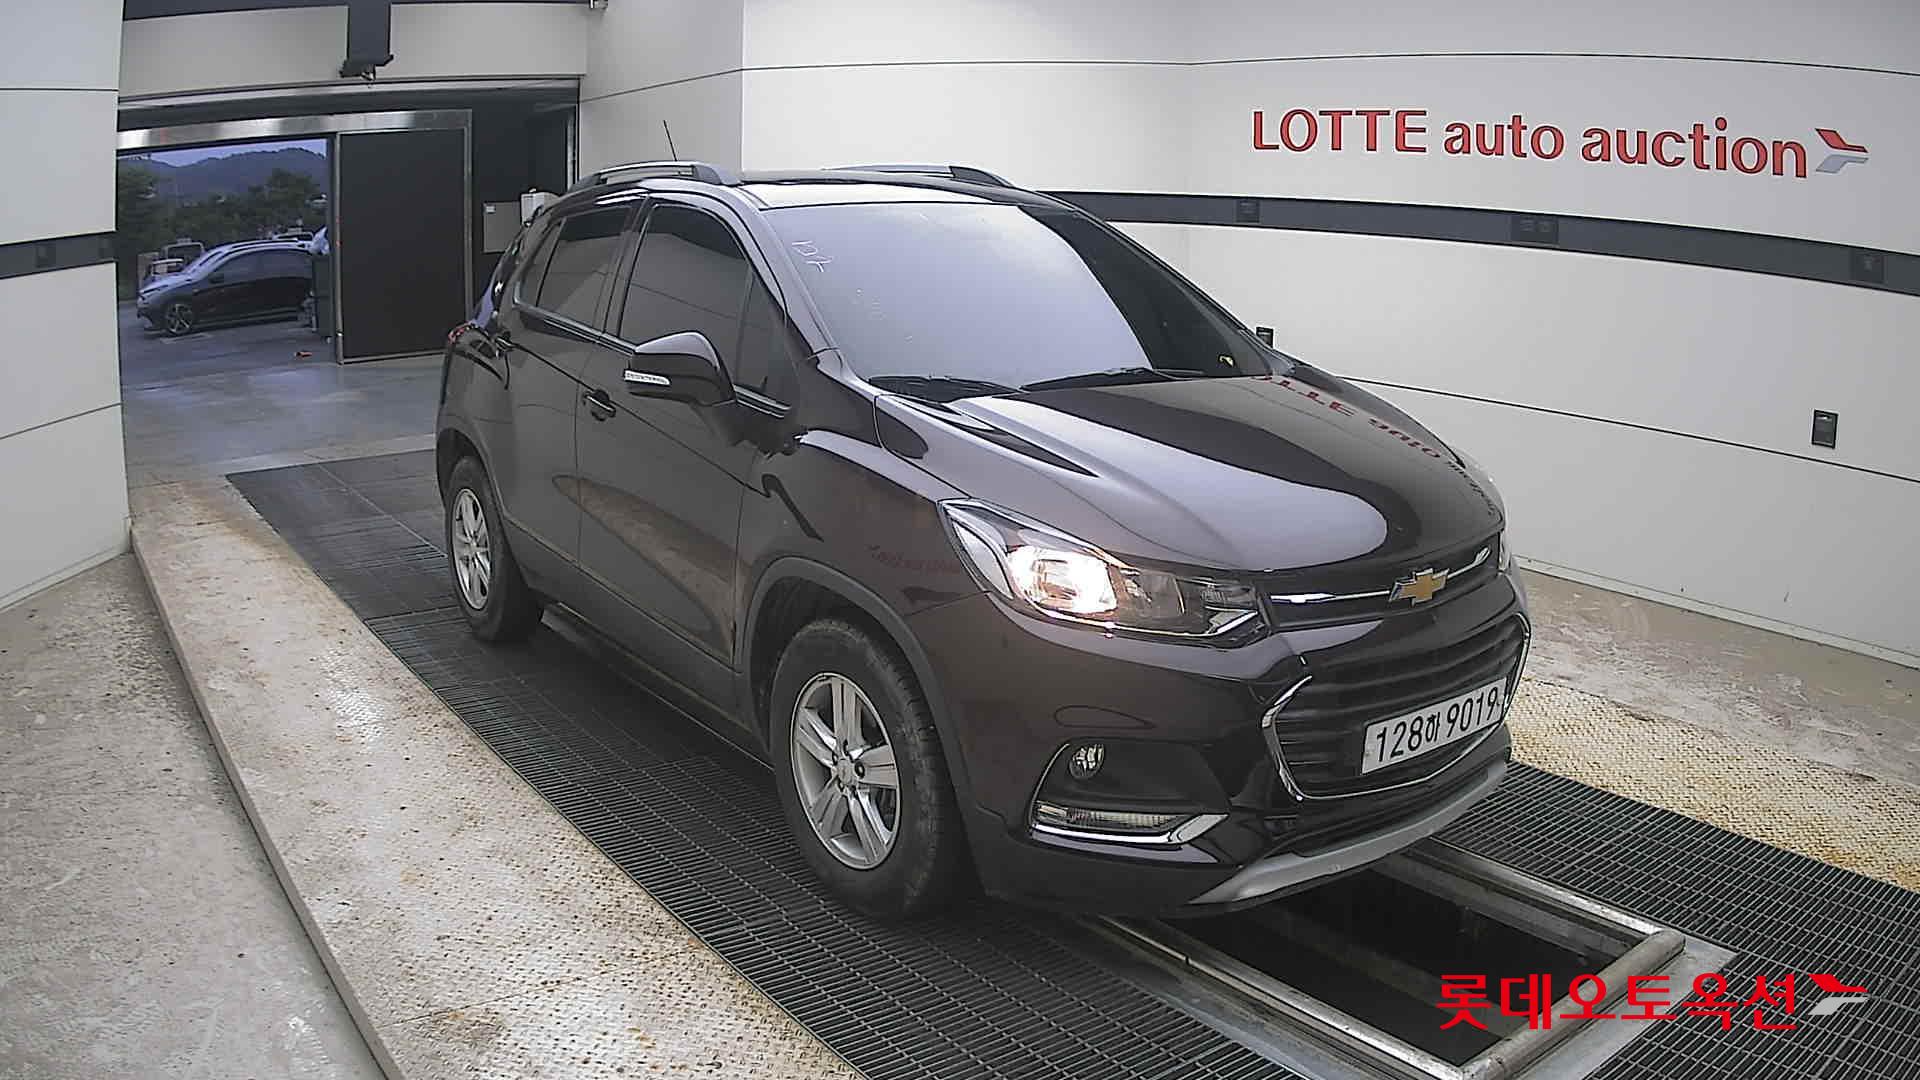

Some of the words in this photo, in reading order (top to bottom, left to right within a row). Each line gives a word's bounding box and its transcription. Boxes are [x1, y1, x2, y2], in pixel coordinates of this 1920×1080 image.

[1252, 109, 1428, 153] LOTTE
[1444, 114, 1565, 160] auto
[1581, 117, 1808, 179] auction
[1447, 686, 1498, 739] 9019
